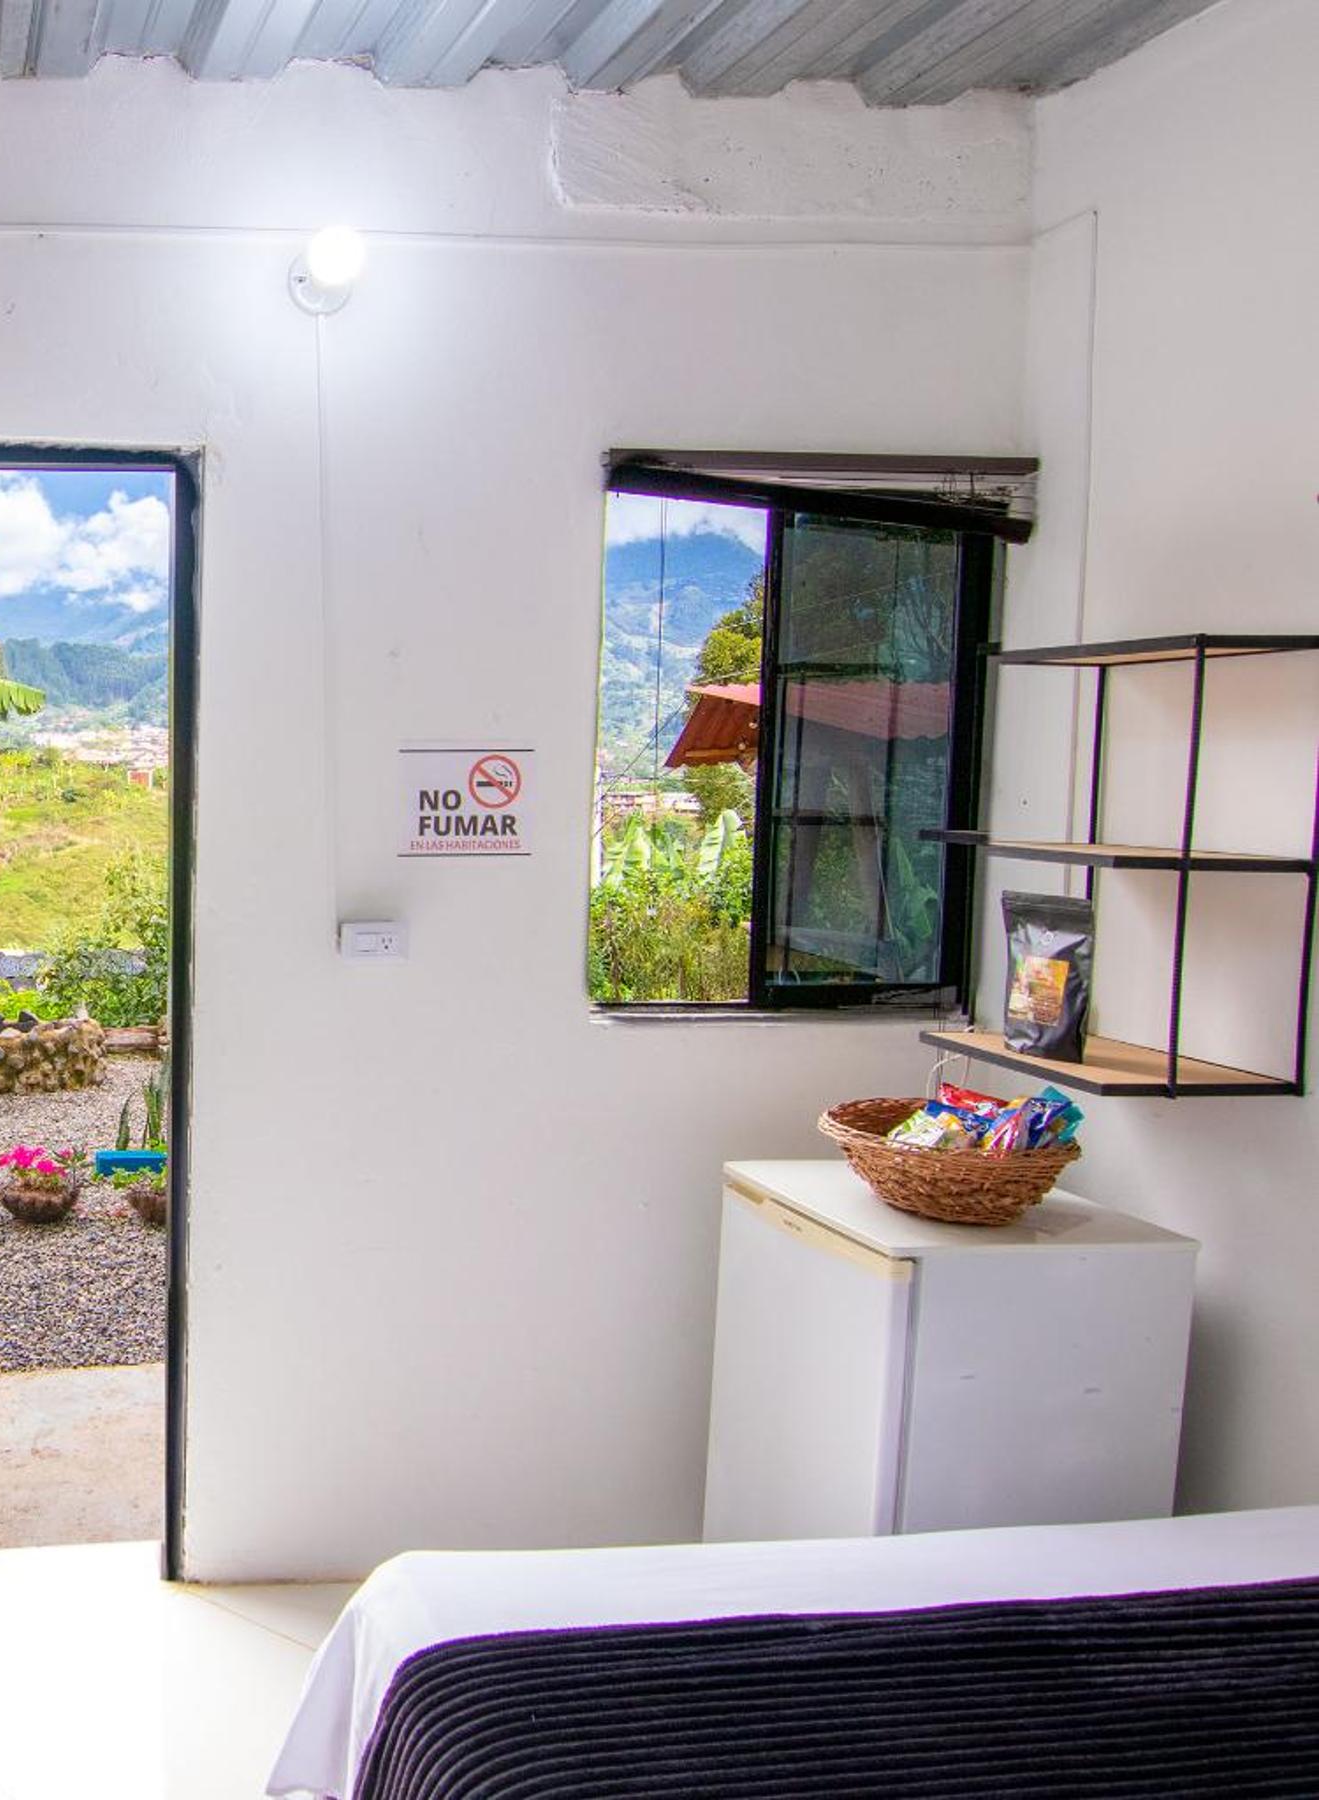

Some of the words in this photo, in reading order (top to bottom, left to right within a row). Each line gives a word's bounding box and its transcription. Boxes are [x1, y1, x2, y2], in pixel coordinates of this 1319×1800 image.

[419, 789, 462, 811] NO
[419, 814, 517, 836] FUMAR
[410, 840, 423, 850] EN
[426, 840, 444, 850] LAS
[446, 839, 521, 850] HABITACIONES
